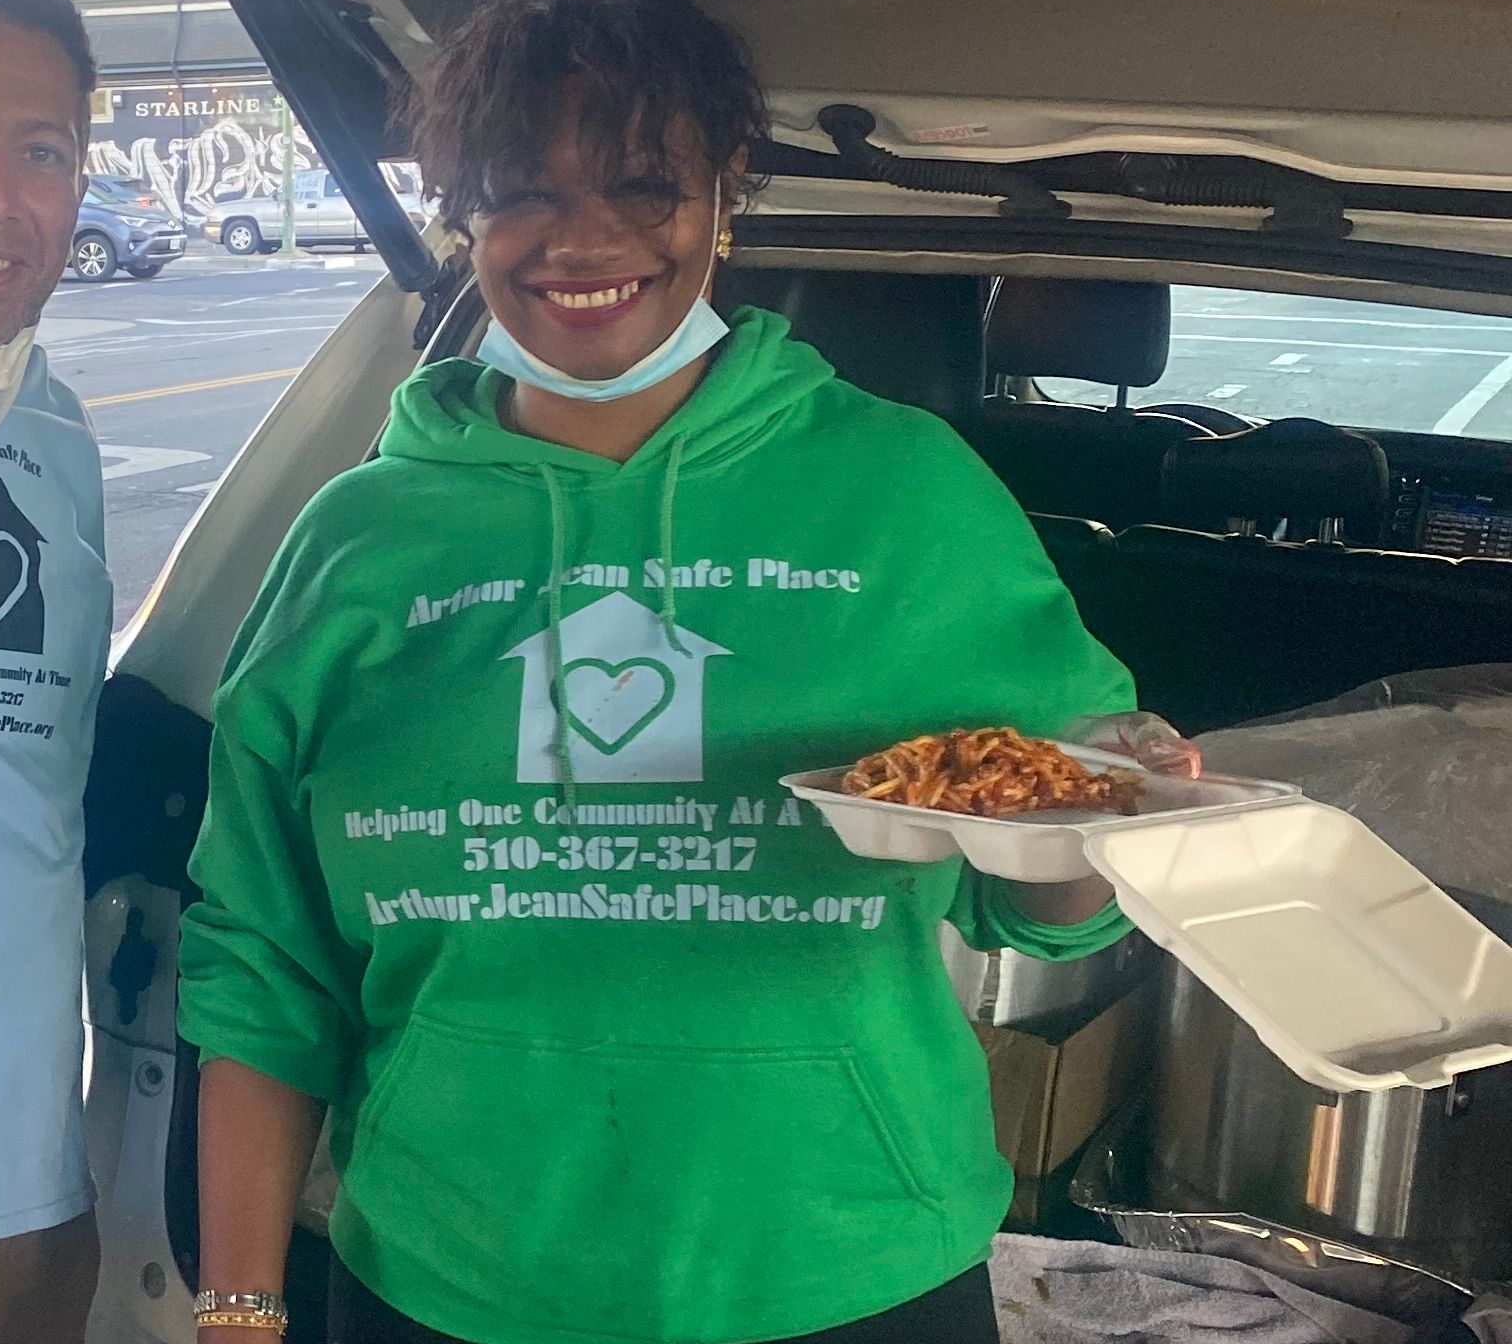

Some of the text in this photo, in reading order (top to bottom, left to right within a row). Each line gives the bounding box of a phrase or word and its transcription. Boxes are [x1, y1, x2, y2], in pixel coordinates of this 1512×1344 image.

[135, 98, 261, 117] STARLINE
[19, 449, 42, 478] Place
[406, 557, 862, 629] Arthur ean Safe Place
[344, 805, 447, 842] Helping
[458, 798, 522, 828] One
[534, 795, 718, 832] Community
[728, 797, 766, 825] At
[776, 798, 803, 828] A
[462, 836, 758, 873] 510-367-3217
[364, 882, 887, 930] ArthurJeanSafePlace.org
